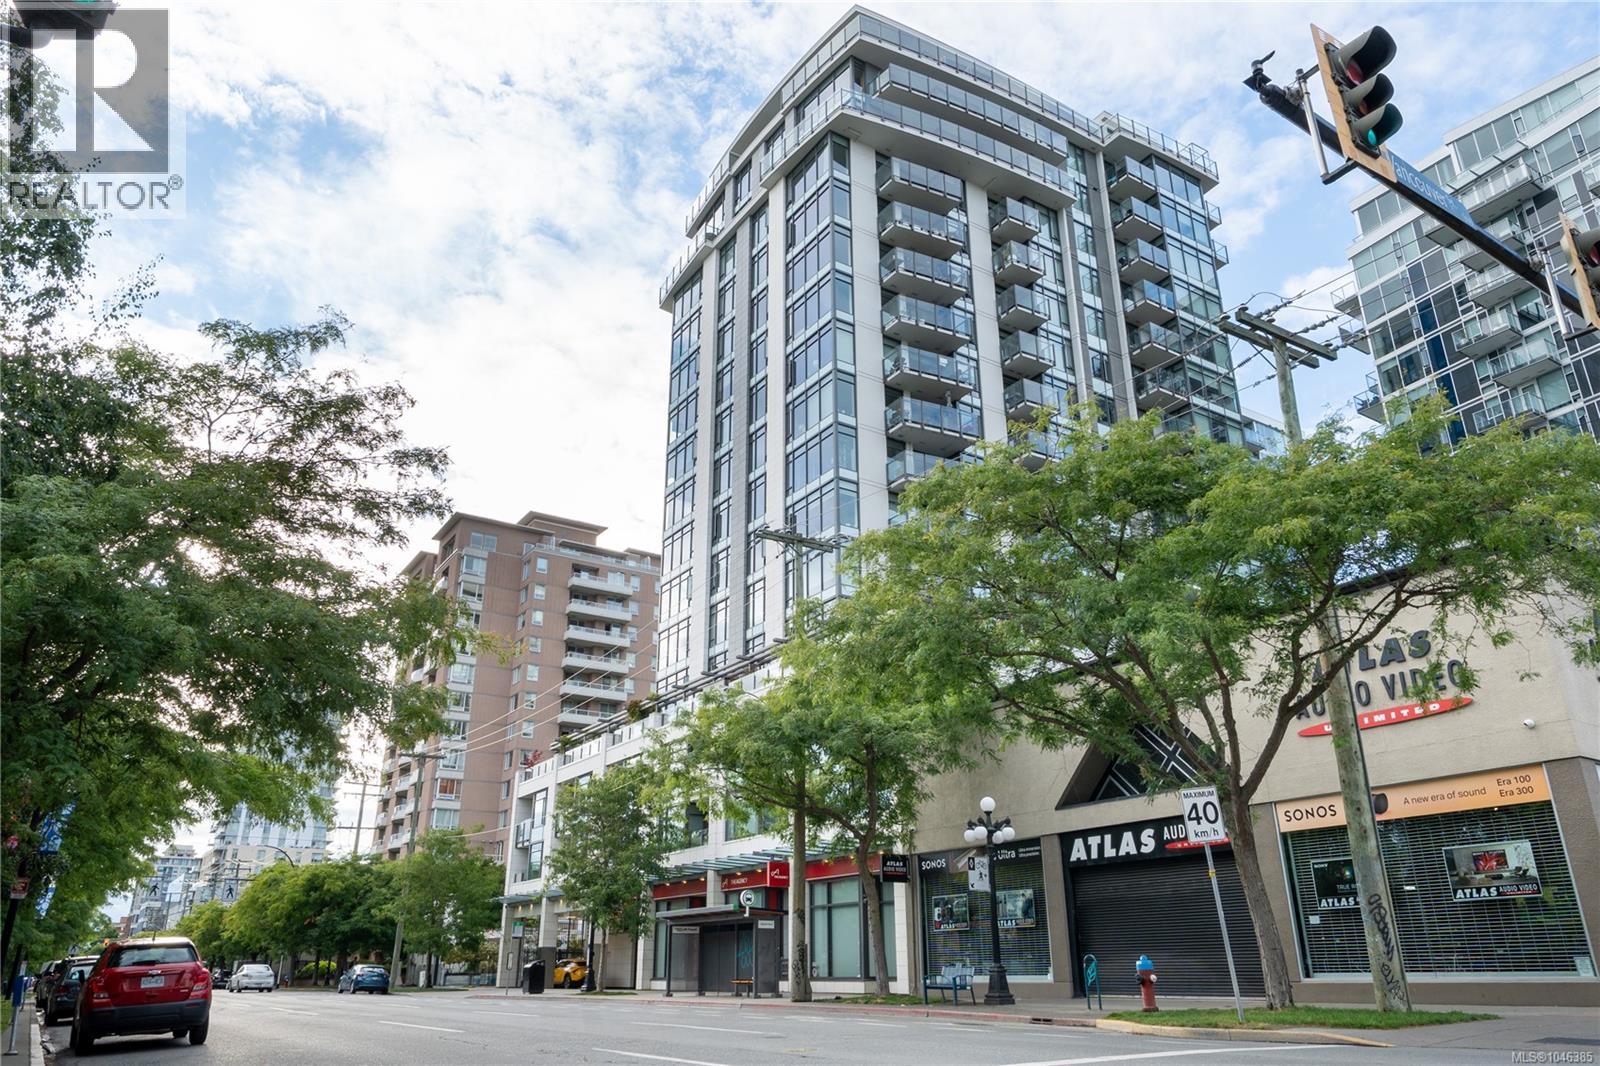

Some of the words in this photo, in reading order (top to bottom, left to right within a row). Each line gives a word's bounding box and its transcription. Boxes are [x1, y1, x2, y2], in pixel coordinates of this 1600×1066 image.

[1324, 702, 1440, 732] UIMITED
[1496, 778, 1512, 786] Era
[1514, 775, 1531, 784] 100
[1182, 790, 1215, 799] MAXIMUM
[1403, 797, 1410, 805] A
[1411, 796, 1429, 804] new
[1446, 790, 1456, 799] of
[1457, 787, 1487, 798] sound
[1499, 789, 1515, 797] Era
[1516, 786, 1534, 794] 300
[1187, 800, 1219, 825] 40
[1284, 804, 1337, 822] SONOS
[1193, 828, 1219, 838] km/h
[1069, 829, 1156, 862] ATLAS
[921, 859, 946, 870] SONOS
[1455, 886, 1498, 899] ATLAS
[1499, 885, 1518, 893] AUDIO
[1519, 883, 1539, 891] VIDEO
[1320, 896, 1355, 908] ATLAS
